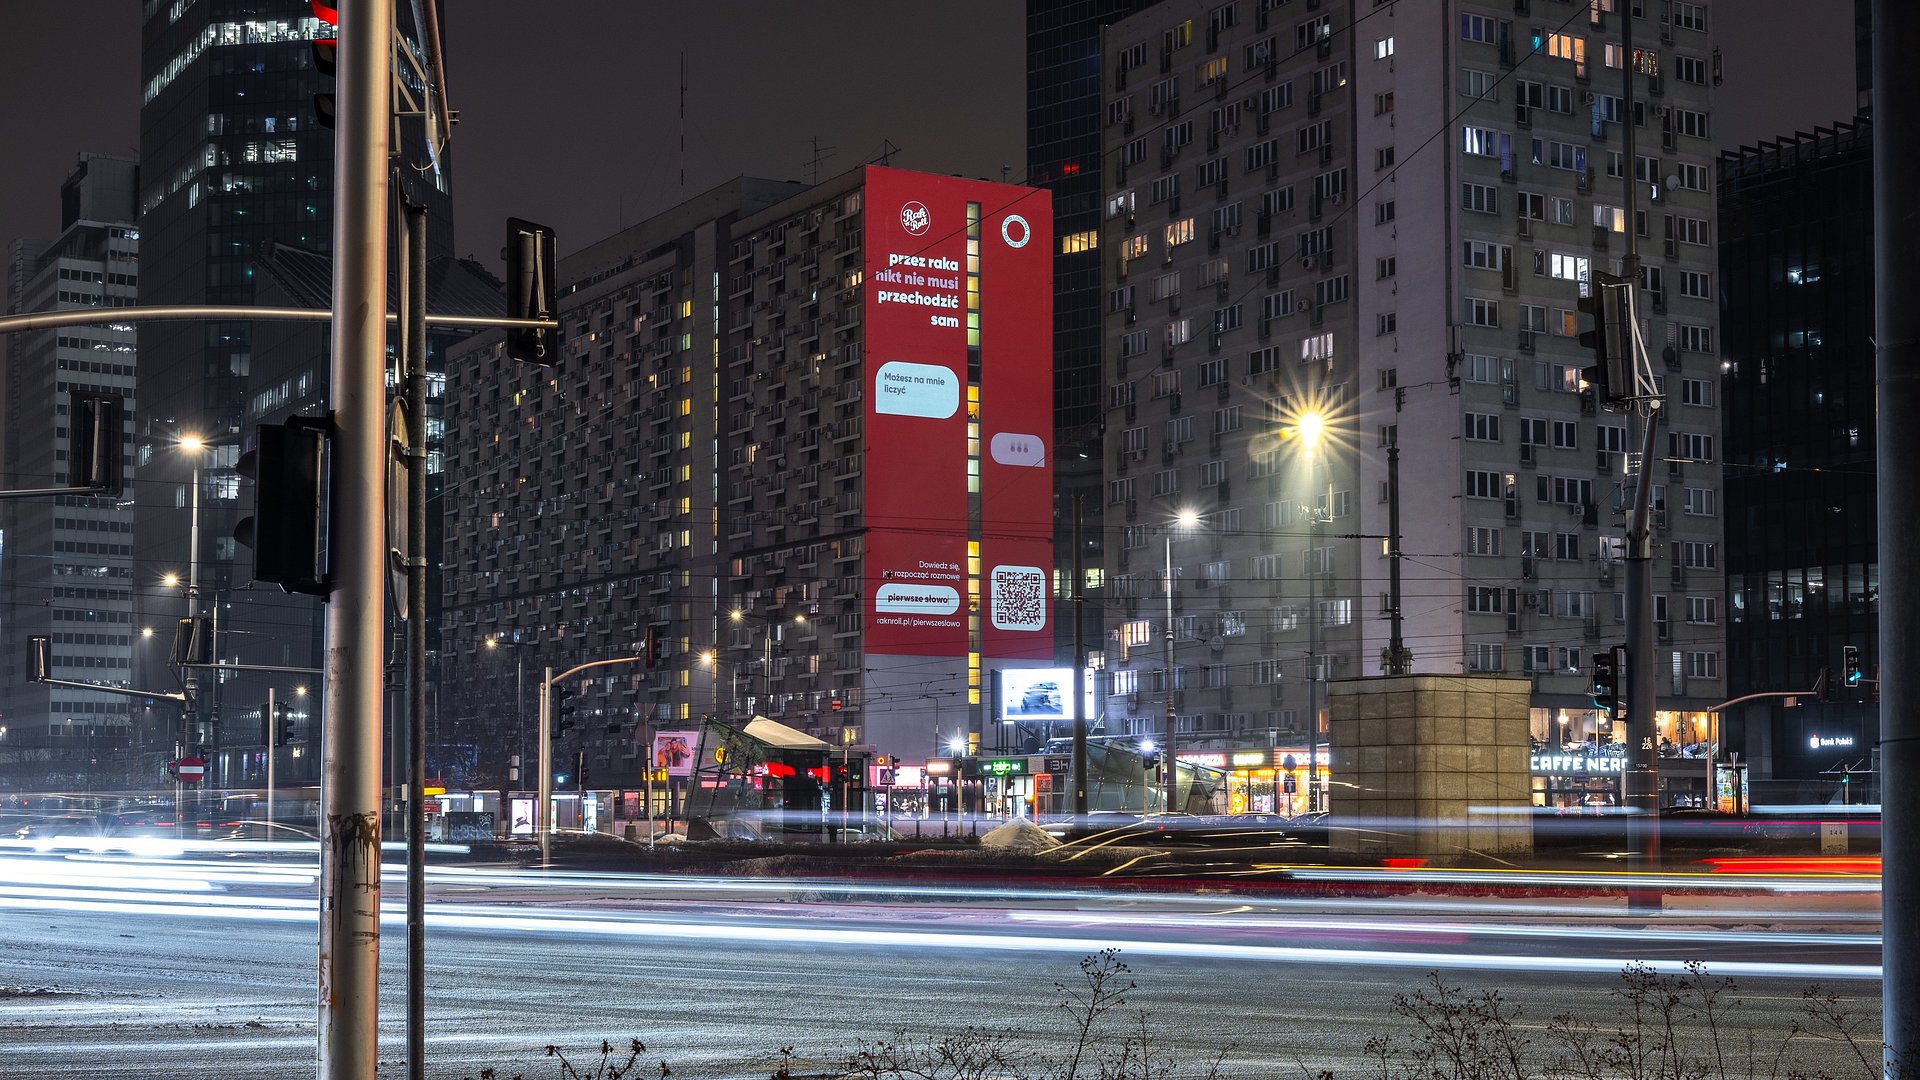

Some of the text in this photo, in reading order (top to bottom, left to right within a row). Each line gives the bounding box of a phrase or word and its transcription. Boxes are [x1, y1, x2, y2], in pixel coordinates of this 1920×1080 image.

[903, 208, 926, 222] Rak
[889, 253, 959, 271] przez raka
[875, 268, 959, 290] nikt nie musi
[878, 290, 959, 309] przechodzić
[930, 315, 959, 328] sam
[884, 372, 946, 386] Możesz na mnie
[884, 384, 906, 395] liczyć
[919, 560, 948, 570] Dowiedz
[894, 571, 930, 579] rozpocząć
[930, 573, 960, 582] rozmowę
[887, 593, 948, 604] pierwsze słowo
[1820, 737, 1835, 746] Bank
